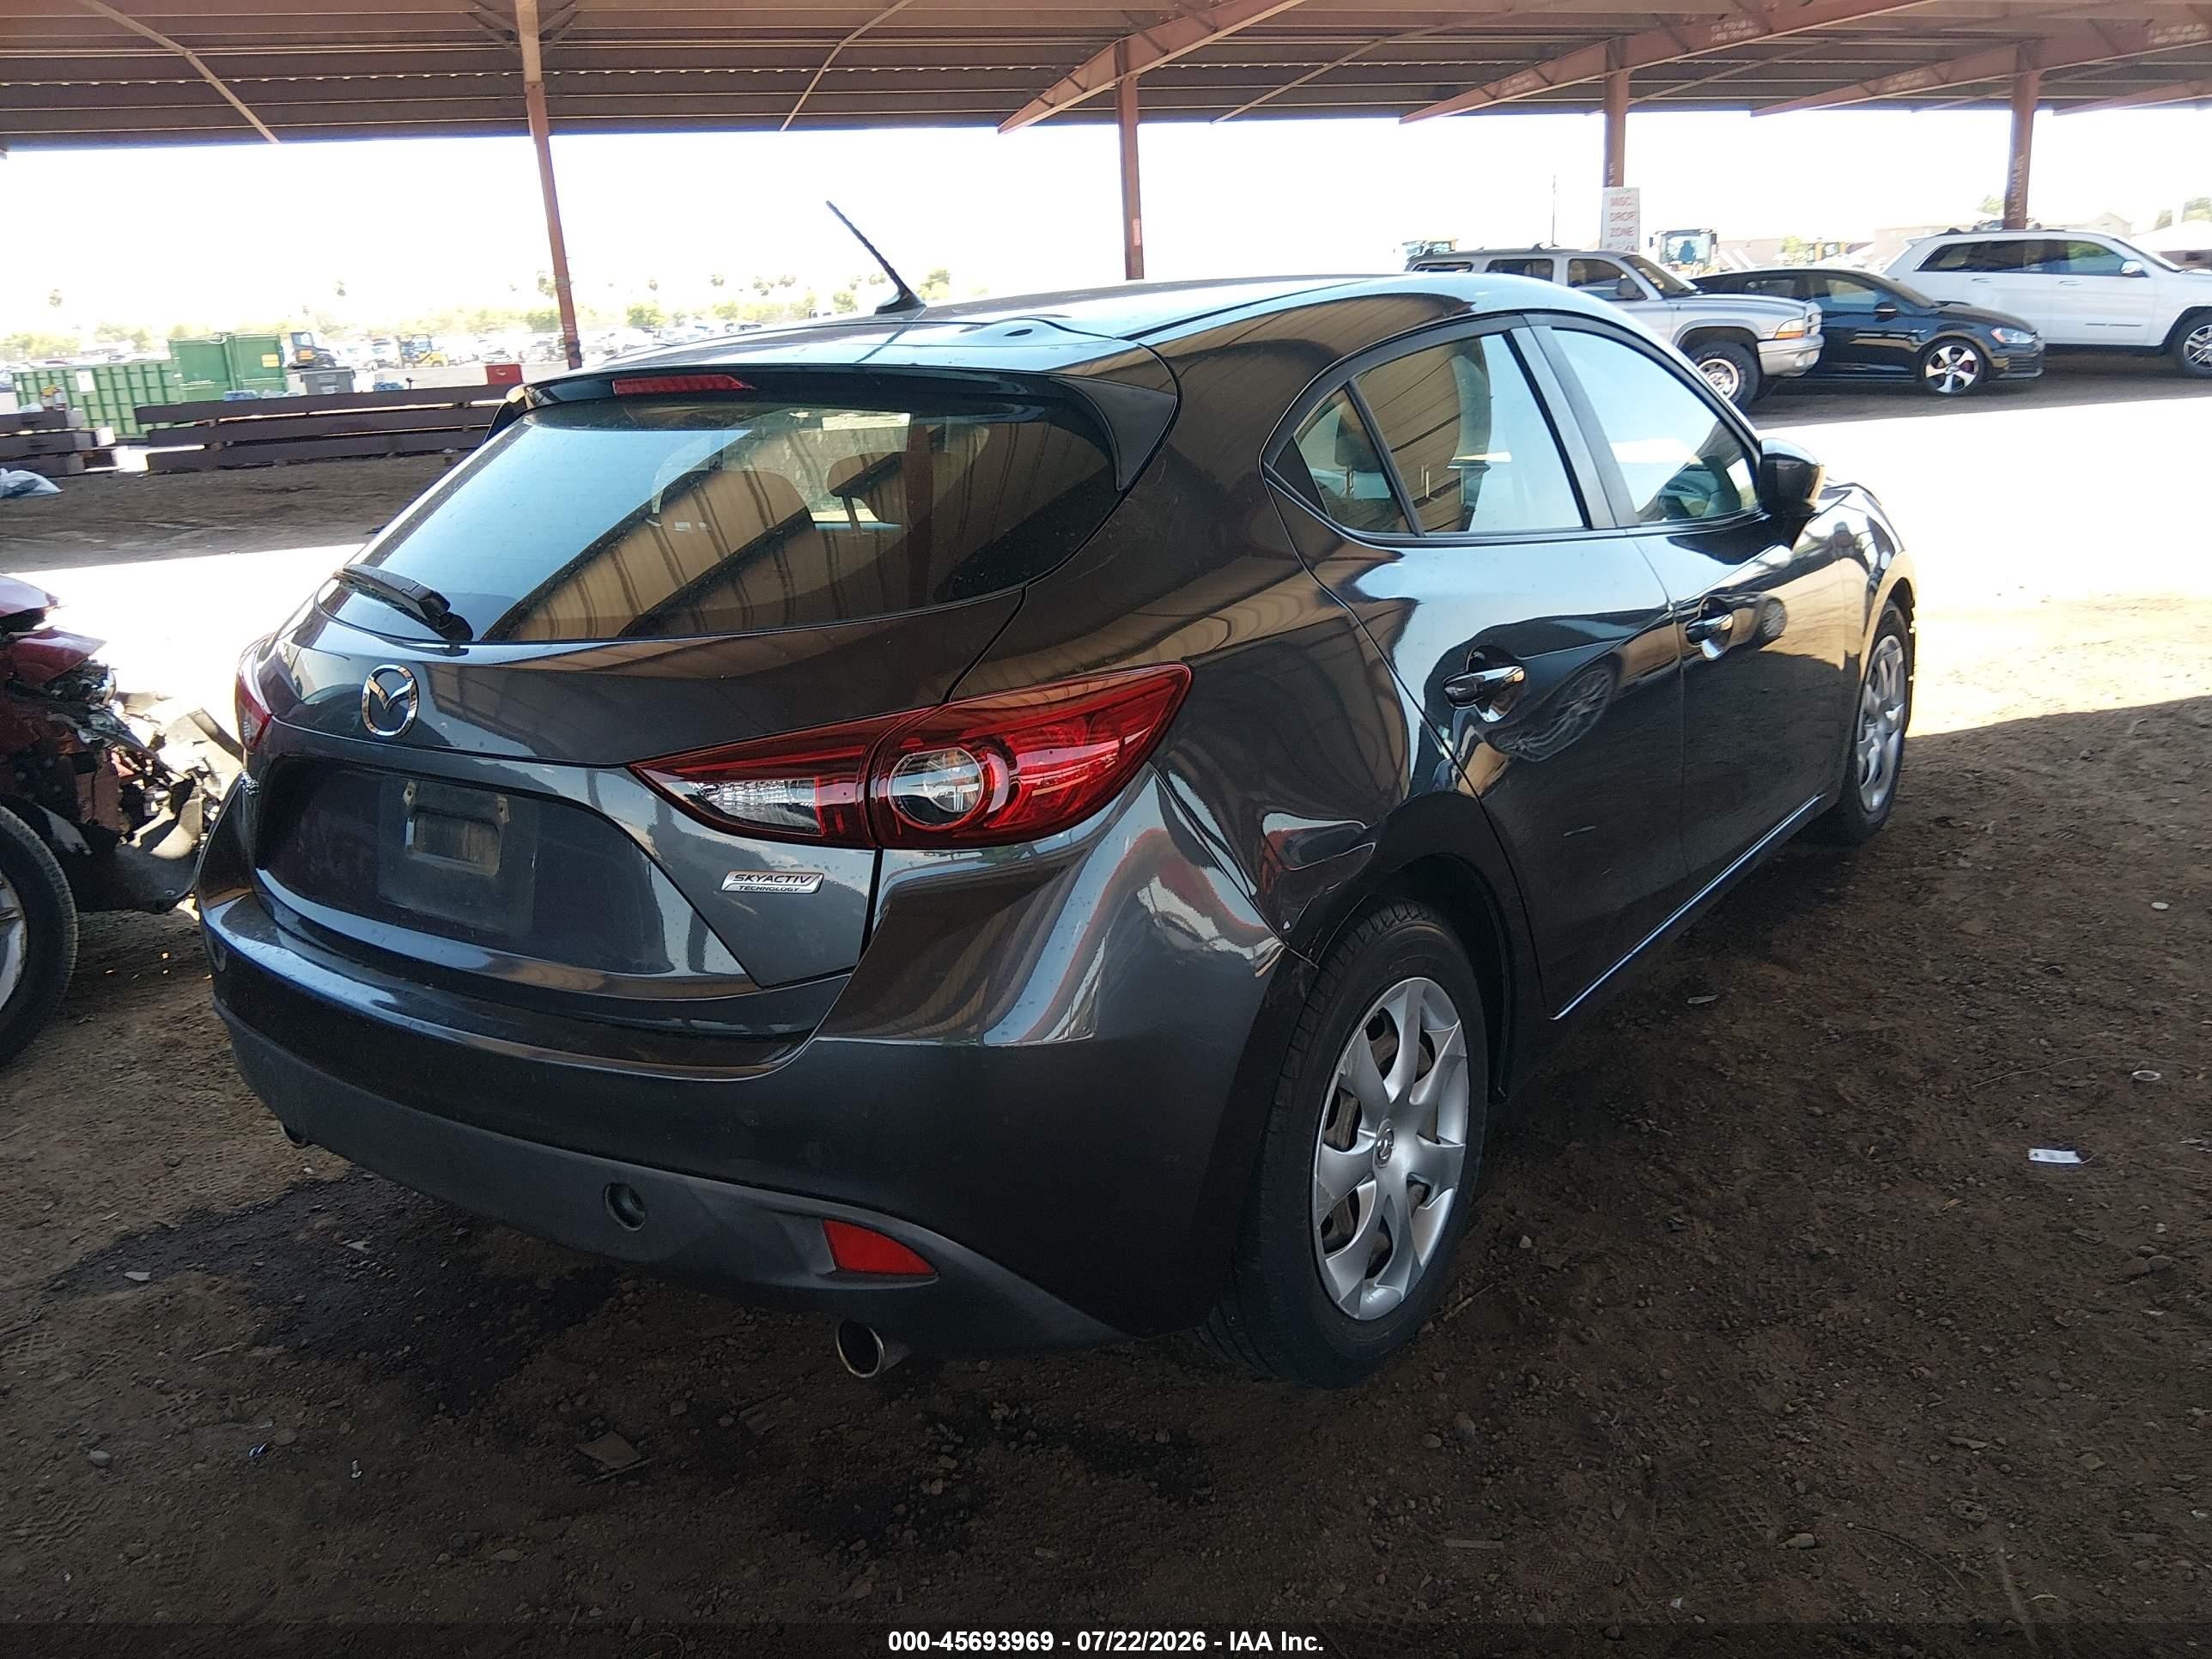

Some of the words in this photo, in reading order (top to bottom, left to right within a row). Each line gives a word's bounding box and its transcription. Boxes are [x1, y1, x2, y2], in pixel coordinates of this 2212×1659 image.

[1609, 211, 1635, 222] DROP
[1609, 227, 1635, 237] ZONE
[732, 873, 812, 884] SKYACTIV
